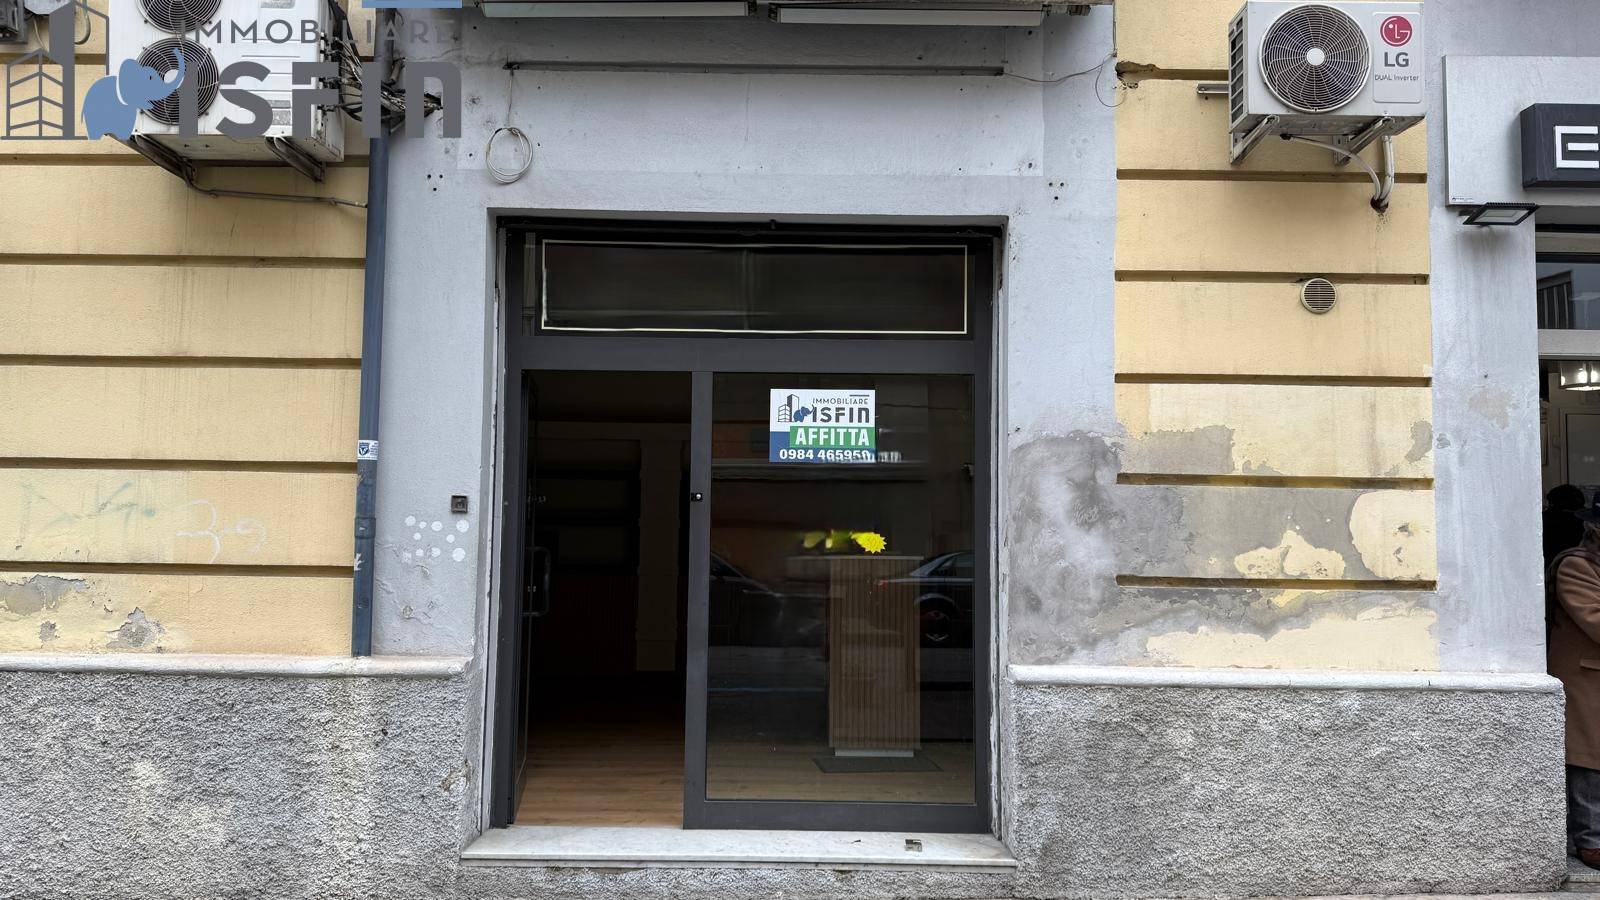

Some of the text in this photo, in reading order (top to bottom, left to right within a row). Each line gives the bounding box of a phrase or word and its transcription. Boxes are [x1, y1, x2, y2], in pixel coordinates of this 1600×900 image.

[1384, 51, 1409, 67] LG
[795, 428, 870, 446] AFFITTA
[779, 449, 814, 460] 0984
